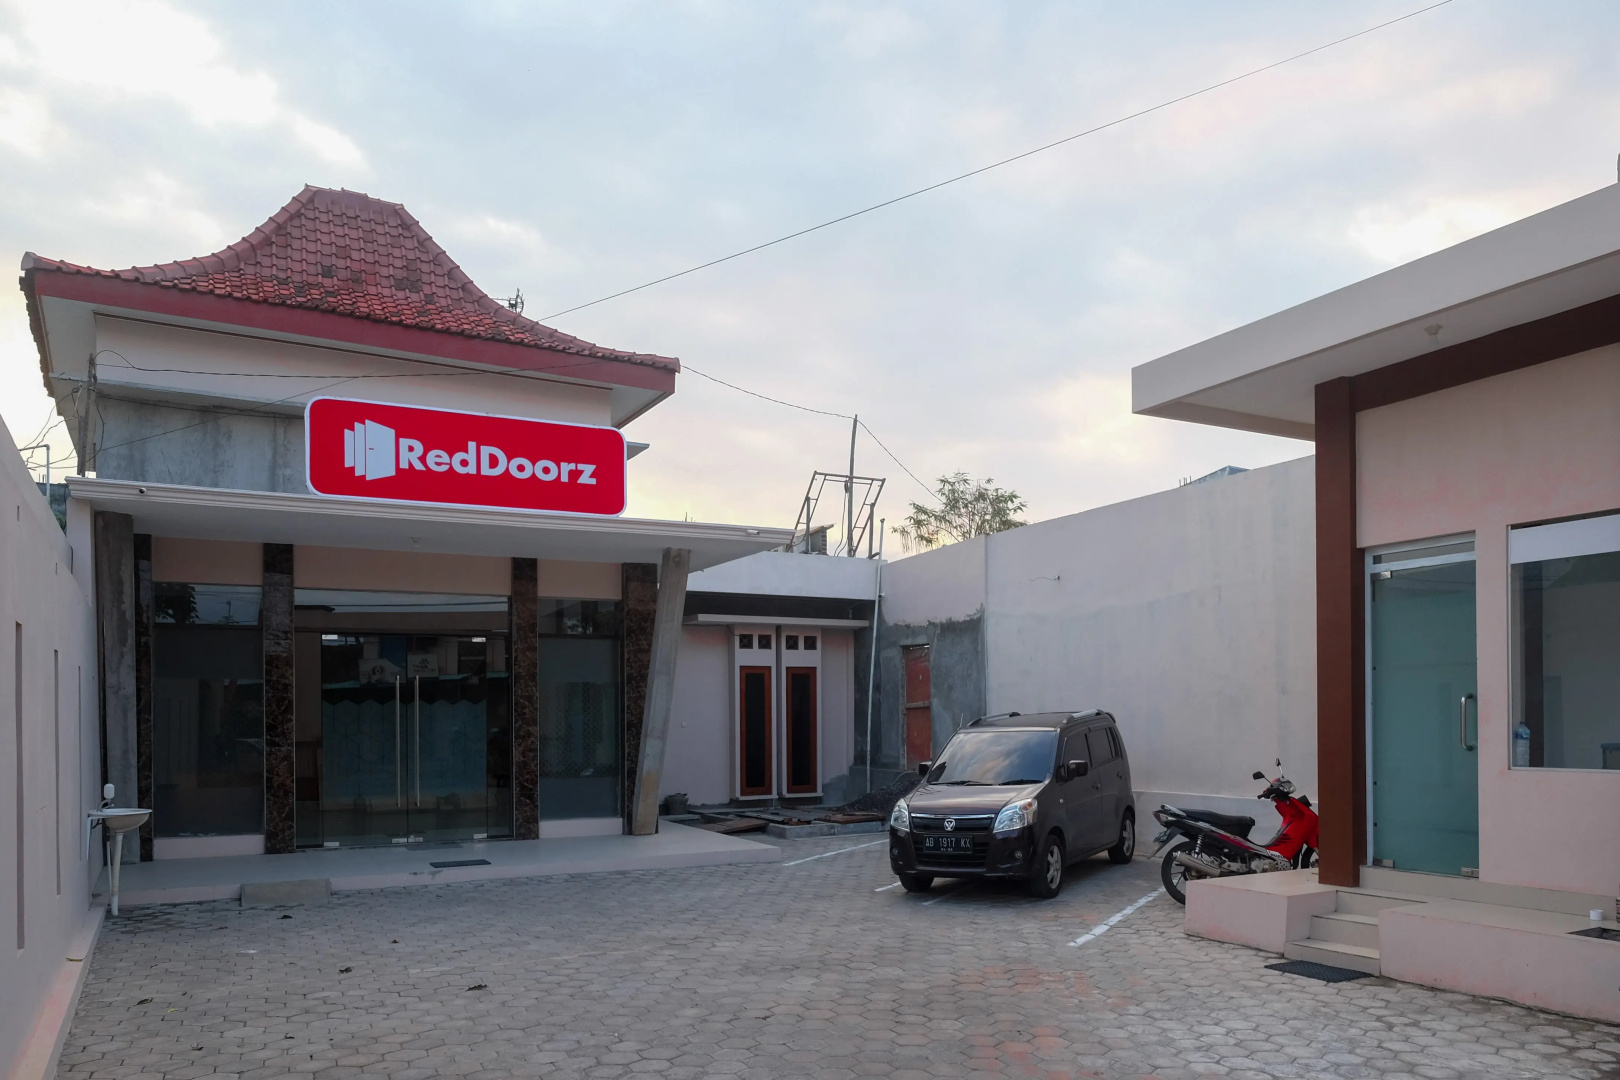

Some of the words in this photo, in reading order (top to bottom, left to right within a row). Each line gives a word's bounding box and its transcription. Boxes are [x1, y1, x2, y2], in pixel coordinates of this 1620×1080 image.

[399, 438, 597, 484] RedDoorz
[925, 837, 934, 847] AB
[939, 838, 956, 848] 1917
[960, 838, 971, 848] KX
